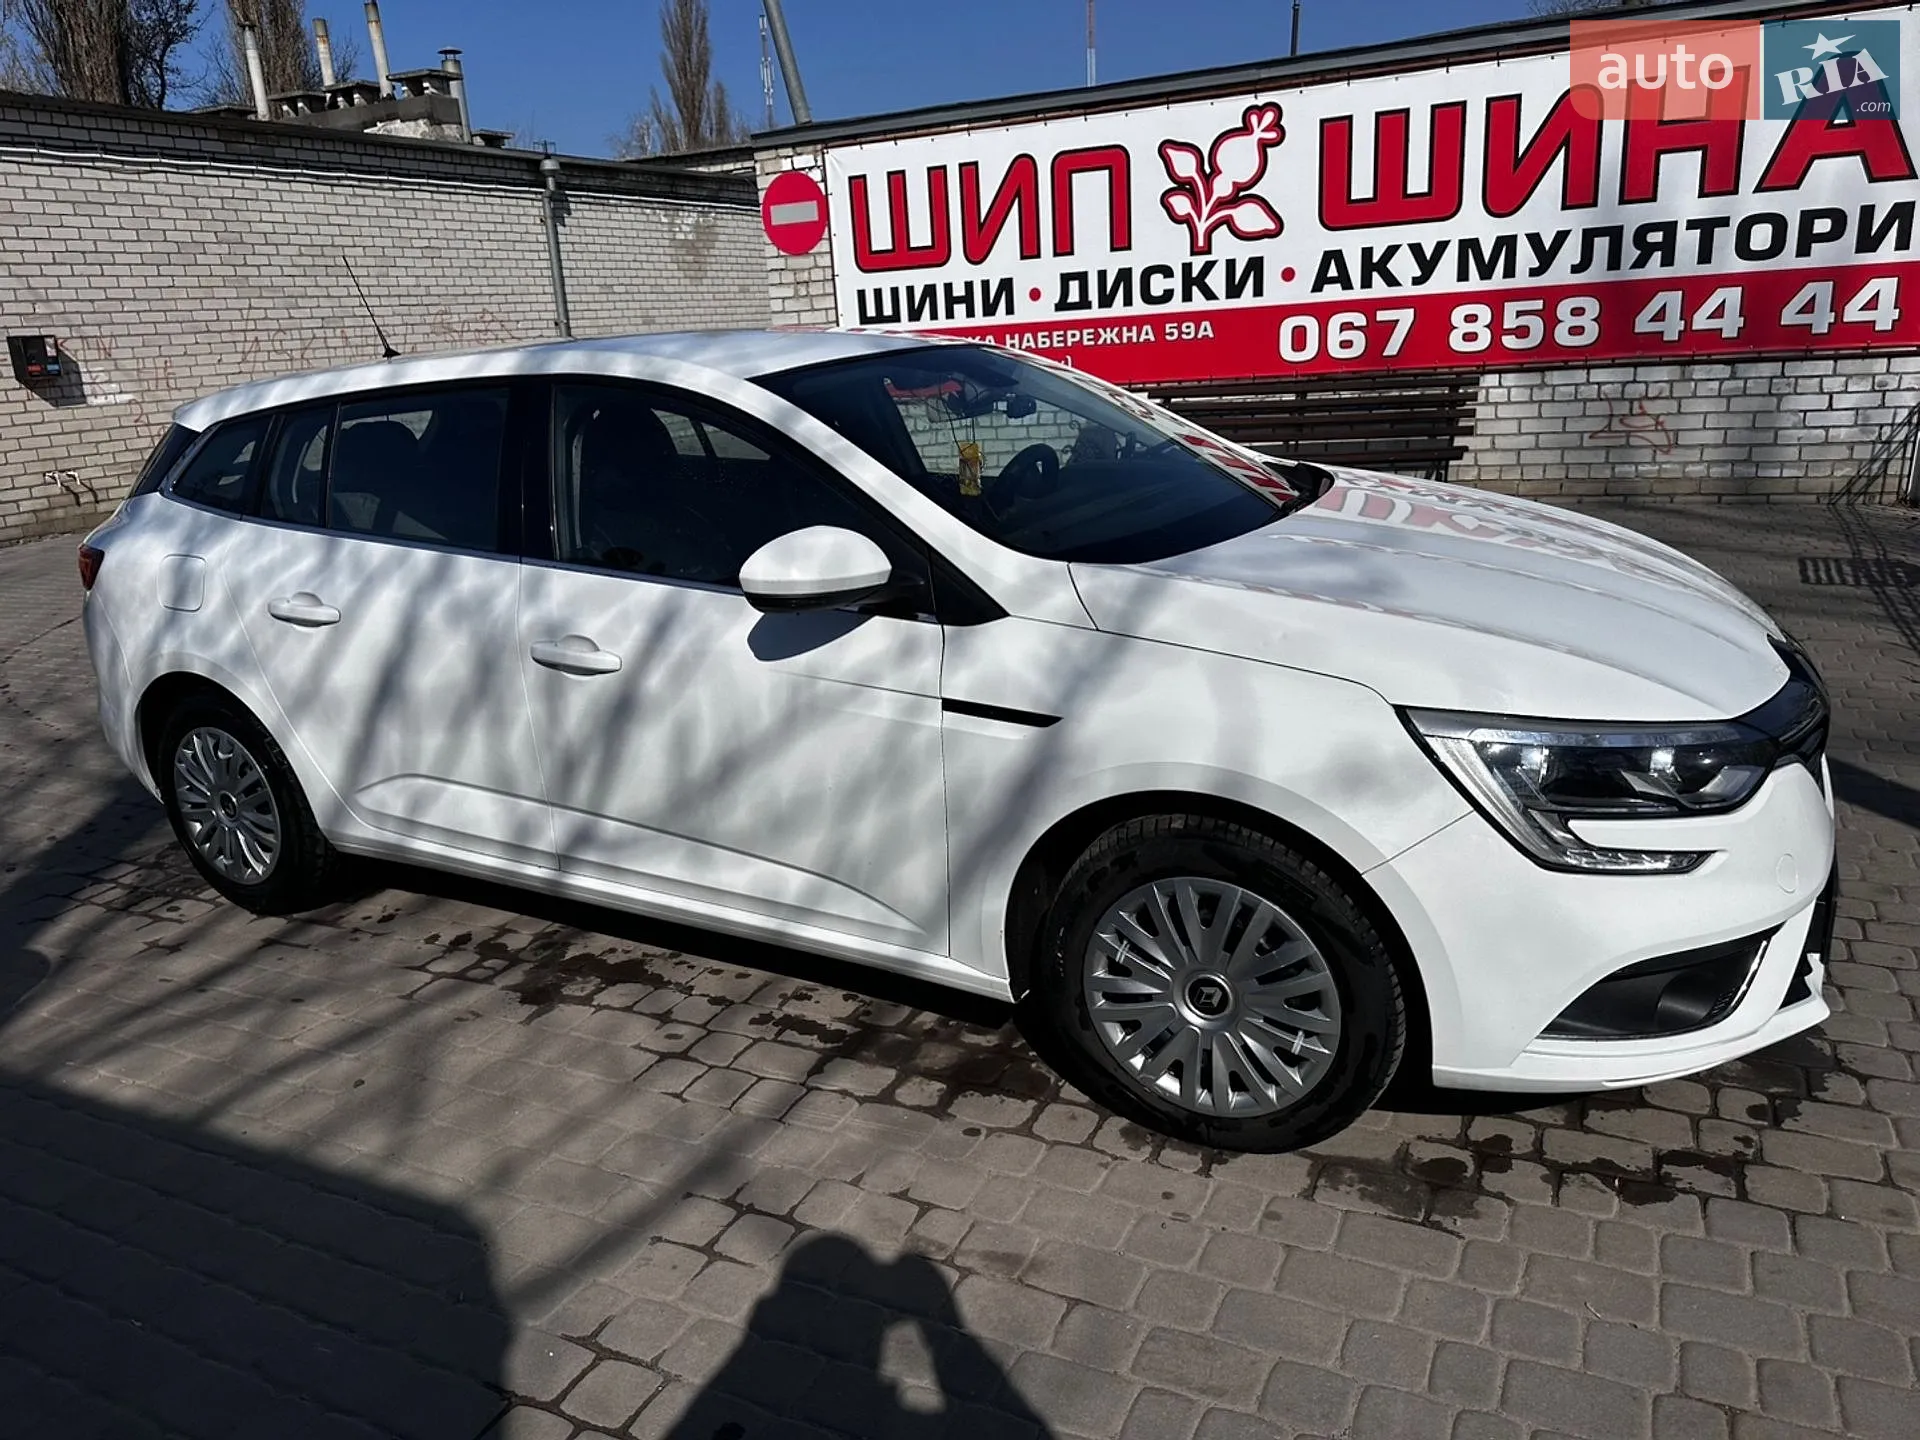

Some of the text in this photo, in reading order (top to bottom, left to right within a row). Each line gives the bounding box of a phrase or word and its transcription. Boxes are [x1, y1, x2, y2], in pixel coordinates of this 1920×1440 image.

[847, 50, 1919, 273] ШИП ШИНА
[857, 200, 1917, 324] ШИНИ ДИСКИ АКУМУЛЯТОРИ
[1005, 323, 1155, 350] НАБЕРЕЖНА
[1279, 277, 1901, 364] 067 858 44 44
